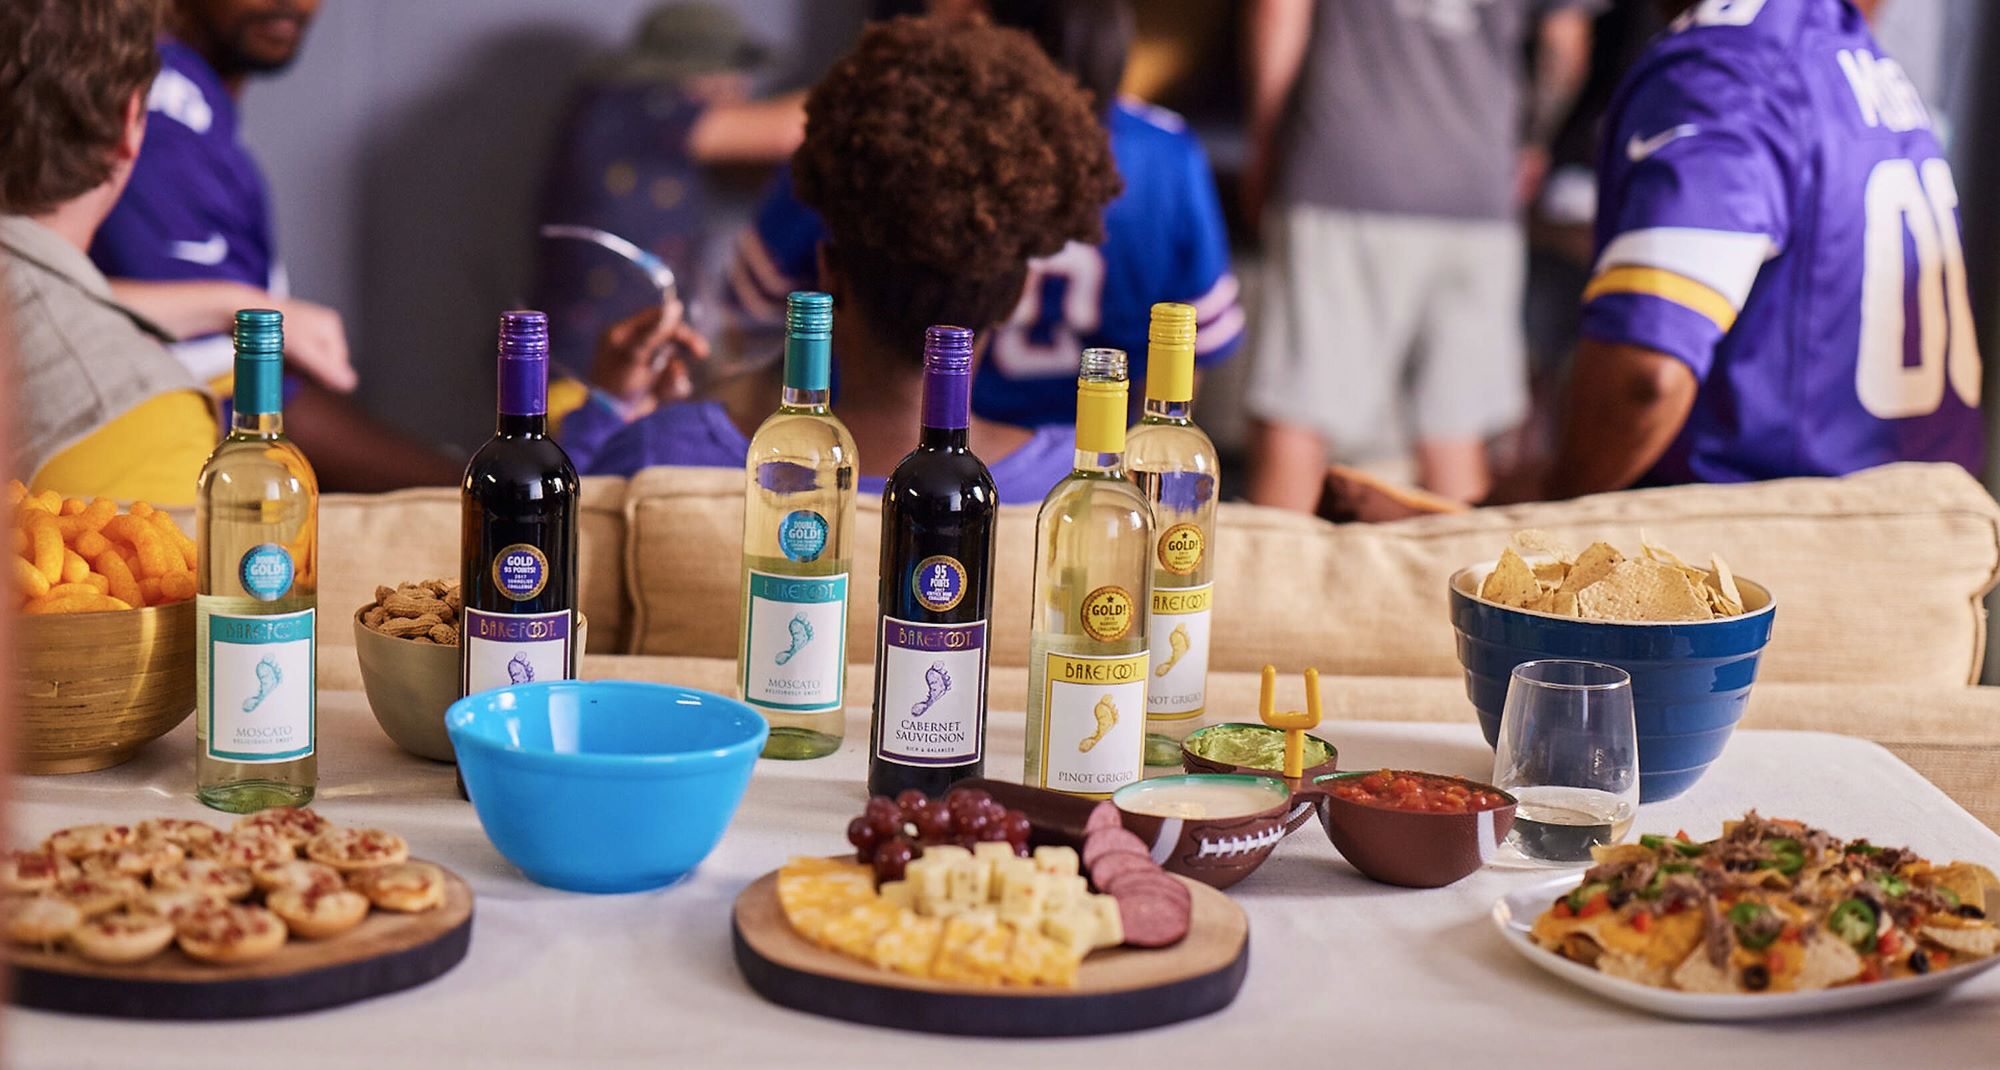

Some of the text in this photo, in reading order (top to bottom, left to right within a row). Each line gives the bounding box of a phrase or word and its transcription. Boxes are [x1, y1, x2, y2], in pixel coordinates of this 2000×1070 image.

[788, 529, 821, 540] GOLD!
[1168, 540, 1199, 551] GOLD!
[507, 556, 534, 567] GOLD
[934, 564, 948, 579] 95
[1153, 593, 1207, 611] AREFOOT
[1092, 605, 1127, 616] GOLD!
[1065, 662, 1138, 681] BAREFOOT
[768, 678, 822, 690] MOSCATO
[1148, 695, 1169, 705] NOT
[235, 725, 293, 738] MOSCATO
[901, 720, 961, 732] CABERNET
[895, 730, 965, 743] SAUVIGNON
[1058, 770, 1134, 783] PINOT GRIGIO
